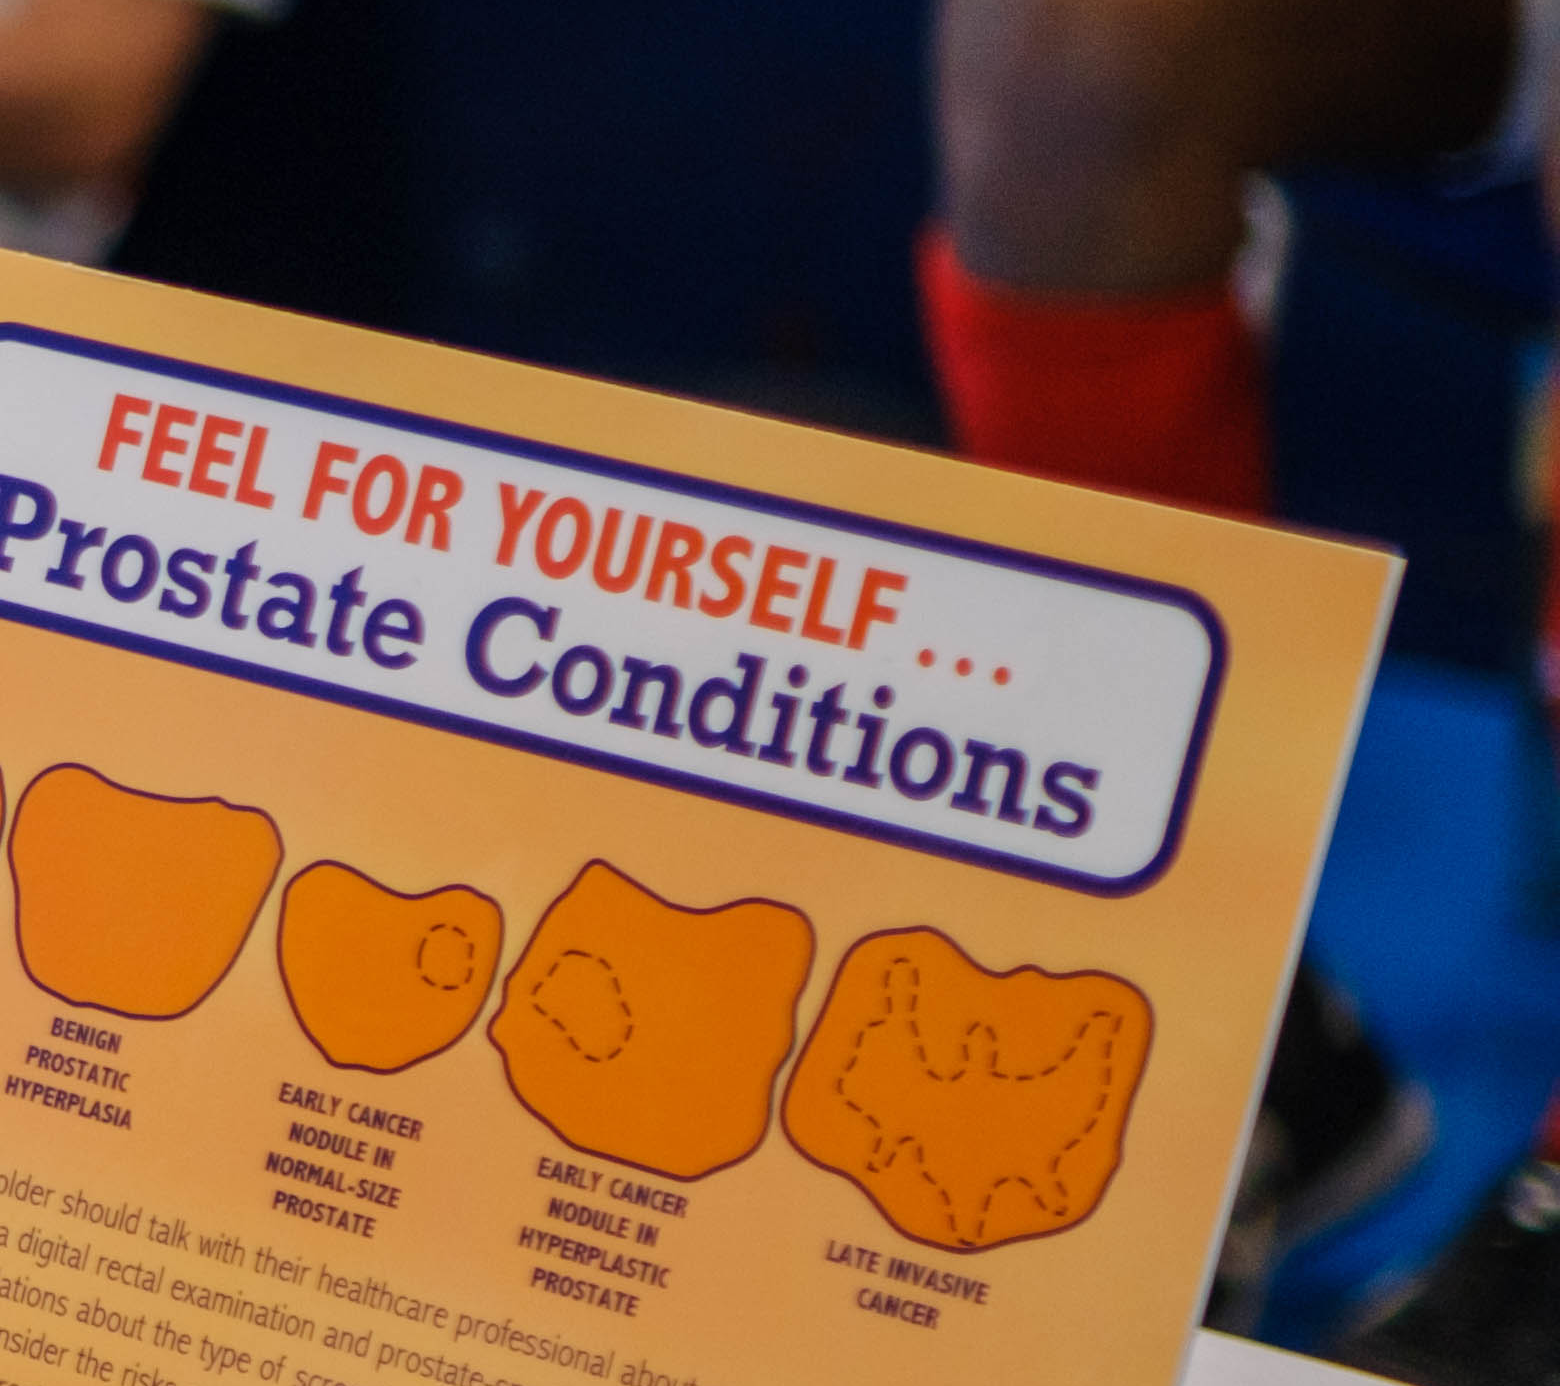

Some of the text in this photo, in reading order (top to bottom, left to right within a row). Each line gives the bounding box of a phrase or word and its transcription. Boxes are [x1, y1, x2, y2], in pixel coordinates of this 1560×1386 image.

[97, 393, 276, 510] FEEL
[301, 440, 464, 552] FOR
[464, 596, 1100, 839] Conditions
[50, 1016, 122, 1054] BENIGN
[24, 1044, 131, 1093] PROSTATIC
[4, 1074, 132, 1130] HYPERPLASIA
[278, 1081, 424, 1142] EARLY CANCER
[287, 1121, 396, 1170] NODULE IN
[264, 1151, 402, 1209] NORMAL-SIZE
[536, 1156, 688, 1218] EARLY CANCER
[271, 1189, 377, 1239] PROSTATE
[546, 1196, 660, 1247] NODULE IN
[59, 1189, 143, 1236] should
[146, 1215, 192, 1252] talk
[198, 1232, 246, 1268] with
[253, 1246, 313, 1286] their
[316, 1263, 449, 1329] healthcare
[453, 1313, 616, 1379] professional
[517, 1225, 670, 1289] HYPERPLASTIC
[825, 1239, 990, 1305] LATE INVASIVE
[17, 1225, 92, 1272] digital
[95, 1255, 166, 1294] rectal
[170, 1279, 316, 1342] examination
[322, 1326, 374, 1358] and
[530, 1266, 641, 1318] PROSTATE
[856, 1287, 940, 1330] CANCER
[75, 1297, 148, 1342] about
[152, 1319, 192, 1356] the
[199, 1334, 252, 1376] type
[258, 1354, 288, 1384] of
[75, 1347, 115, 1383] the
